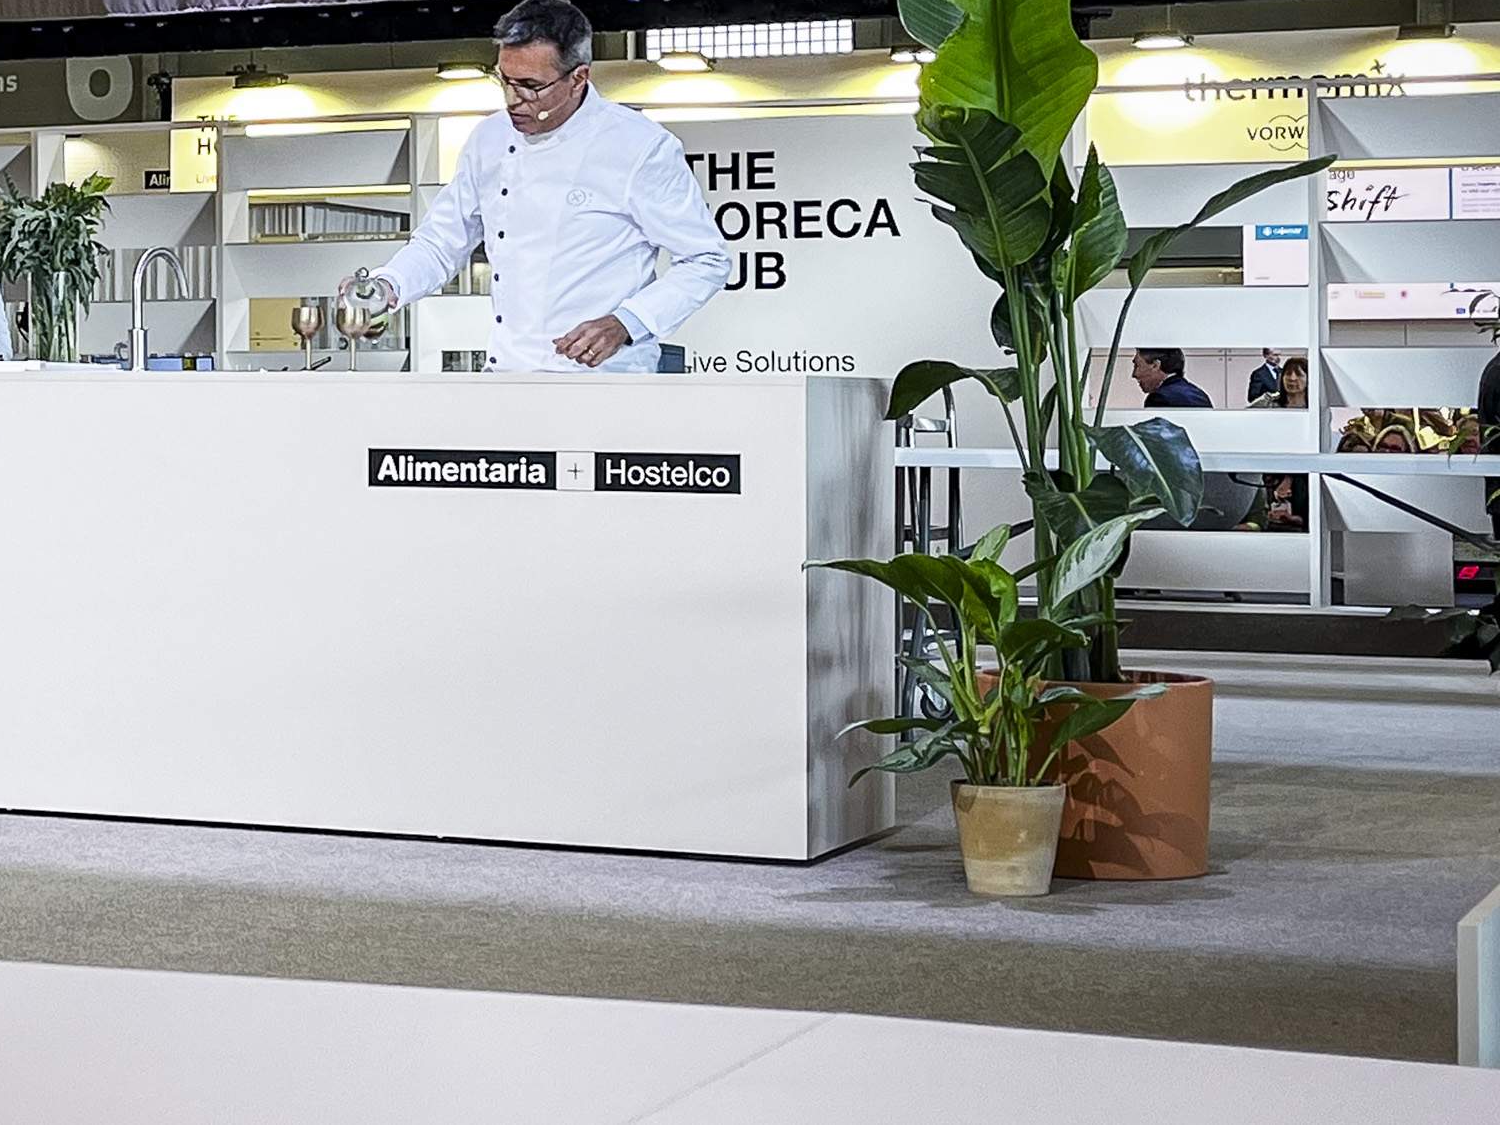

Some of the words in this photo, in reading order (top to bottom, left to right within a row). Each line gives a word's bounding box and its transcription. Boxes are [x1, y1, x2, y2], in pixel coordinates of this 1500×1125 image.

[714, 198, 901, 241] ORECA
[723, 252, 787, 291] UB
[690, 350, 728, 373] ive
[736, 350, 856, 373] Solutions
[377, 454, 547, 484] Alimentaria
[605, 458, 731, 487] Hostelco
